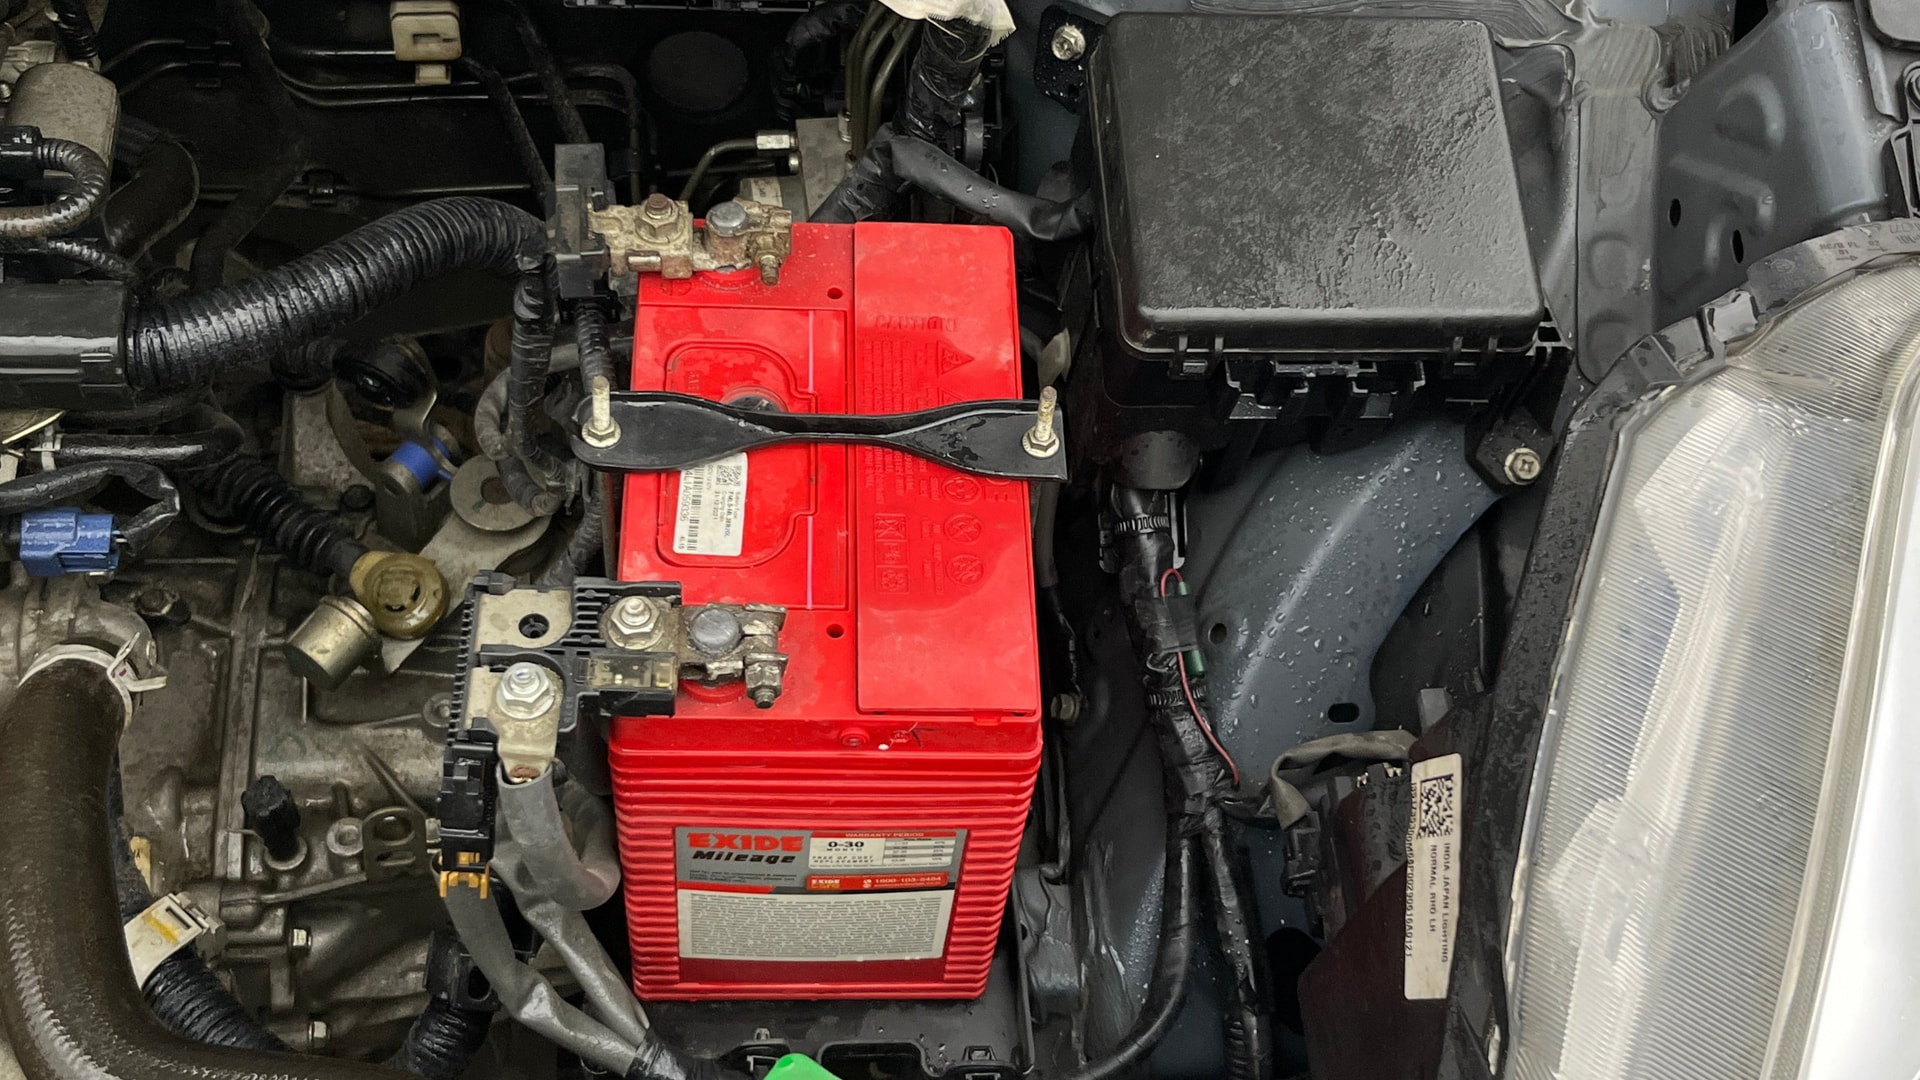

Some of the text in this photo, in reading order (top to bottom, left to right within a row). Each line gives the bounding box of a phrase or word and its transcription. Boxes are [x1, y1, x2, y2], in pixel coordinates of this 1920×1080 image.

[687, 832, 804, 852] EXIDE
[1442, 842, 1451, 871] INDIA
[692, 850, 796, 864] Mileage
[1429, 845, 1438, 889] NORMAL
[1441, 875, 1451, 909] JAPAN
